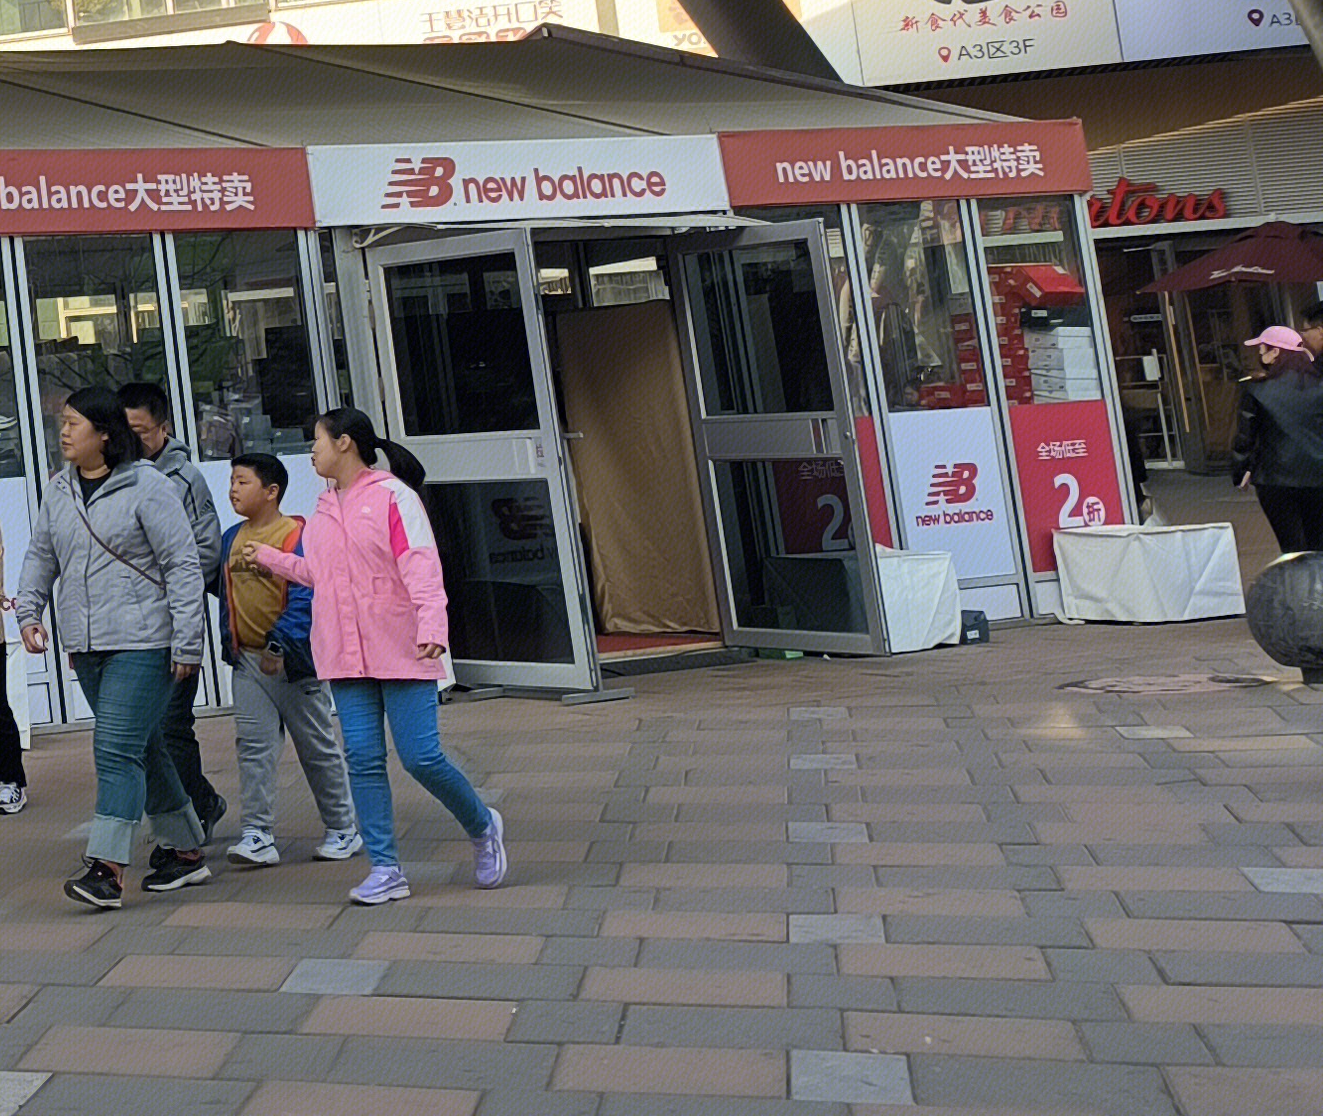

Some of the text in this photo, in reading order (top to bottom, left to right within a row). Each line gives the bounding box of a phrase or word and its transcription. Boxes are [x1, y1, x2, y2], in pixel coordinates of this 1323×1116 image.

[899, 0, 1068, 33] 新食代美食公园
[957, 38, 1035, 61] A3区3F
[775, 143, 1045, 183] new balance大型特卖
[462, 175, 526, 203] new
[533, 167, 667, 202] balance
[1037, 440, 1088, 460] 全场低至
[916, 508, 994, 527] new balance
